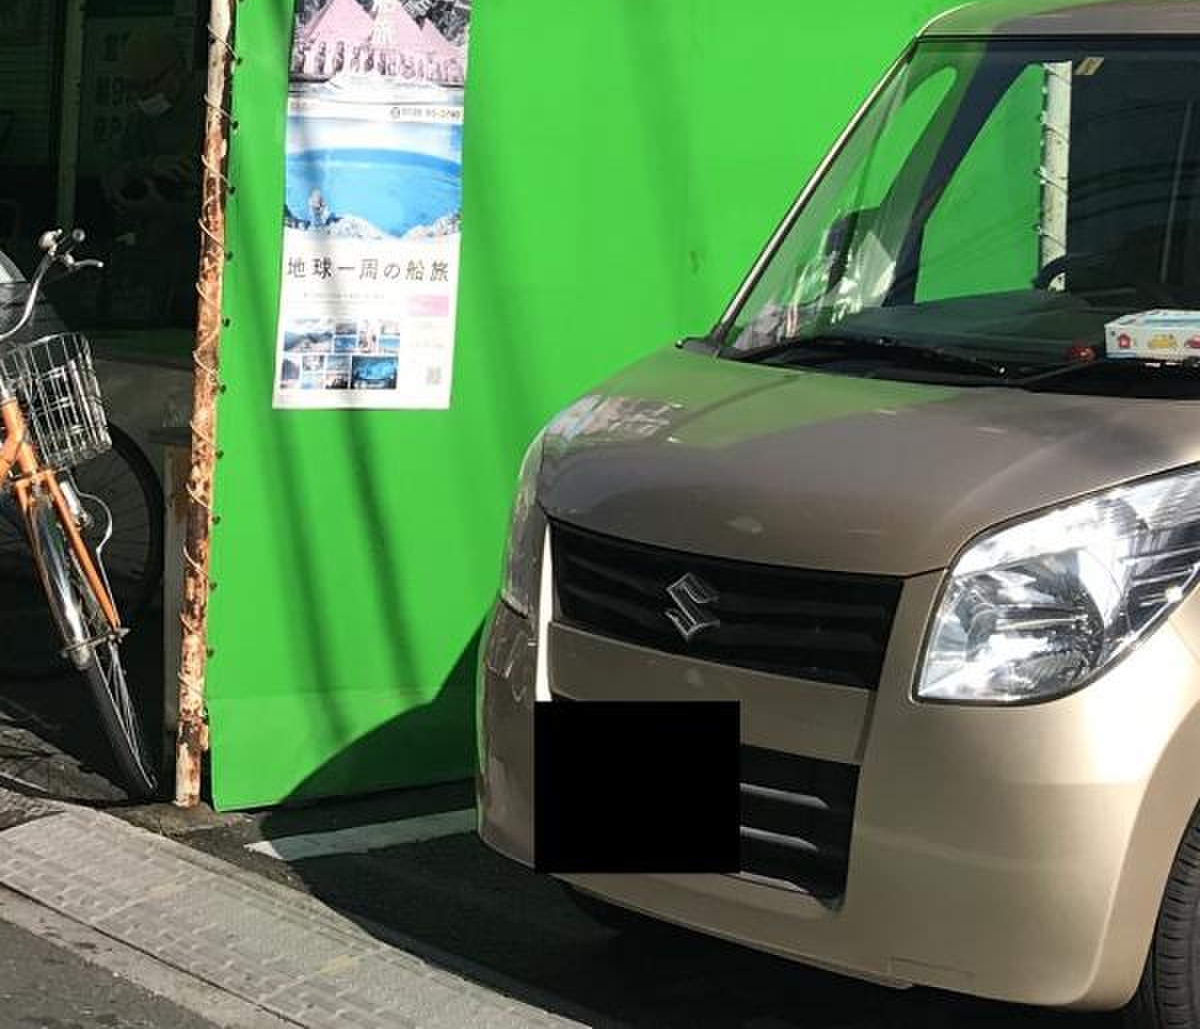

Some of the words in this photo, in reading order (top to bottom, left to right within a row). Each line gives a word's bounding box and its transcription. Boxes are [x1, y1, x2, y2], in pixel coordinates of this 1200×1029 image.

[287, 256, 449, 282] 地球一周の船旅
